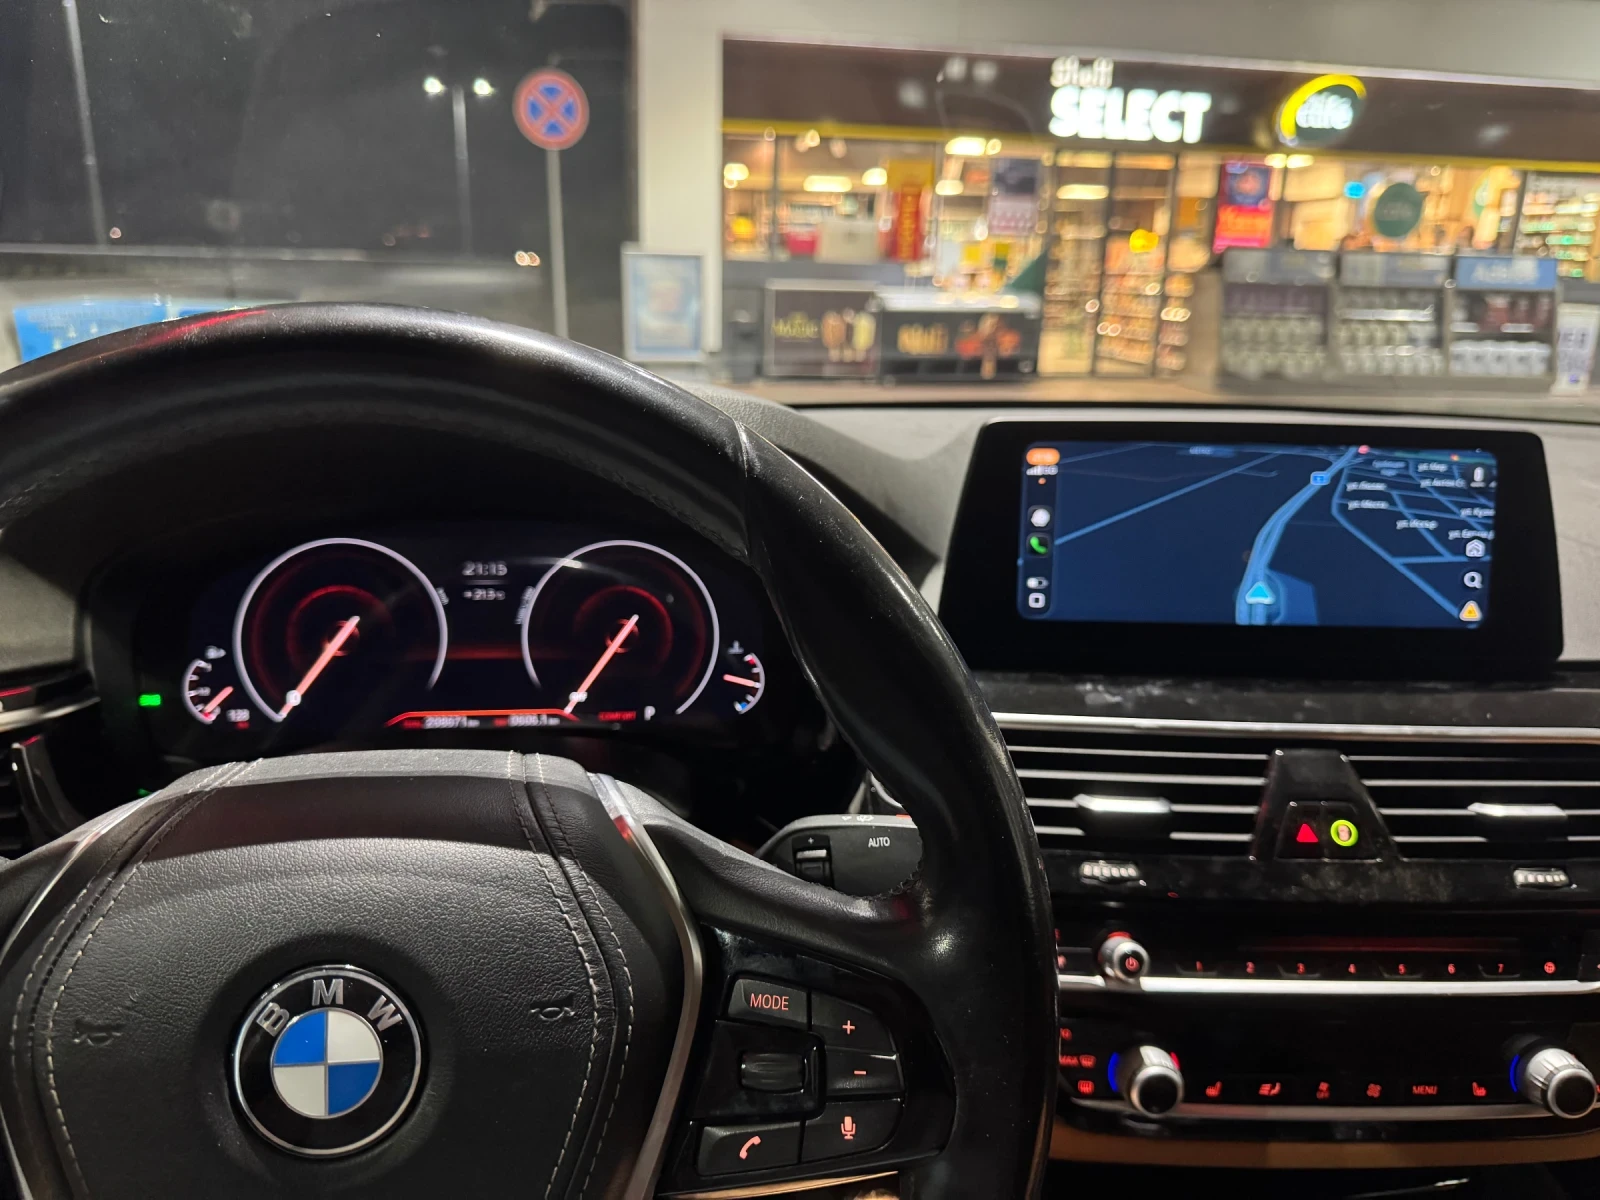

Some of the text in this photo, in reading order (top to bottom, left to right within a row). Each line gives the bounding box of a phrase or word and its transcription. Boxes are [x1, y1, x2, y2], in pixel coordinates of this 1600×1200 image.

[1050, 85, 1212, 143] SELECT
[644, 705, 656, 721] P
[868, 837, 890, 847] AUTO
[256, 978, 403, 1037] BMW
[750, 993, 790, 1010] MODE
[1412, 1085, 1438, 1095] MENU
